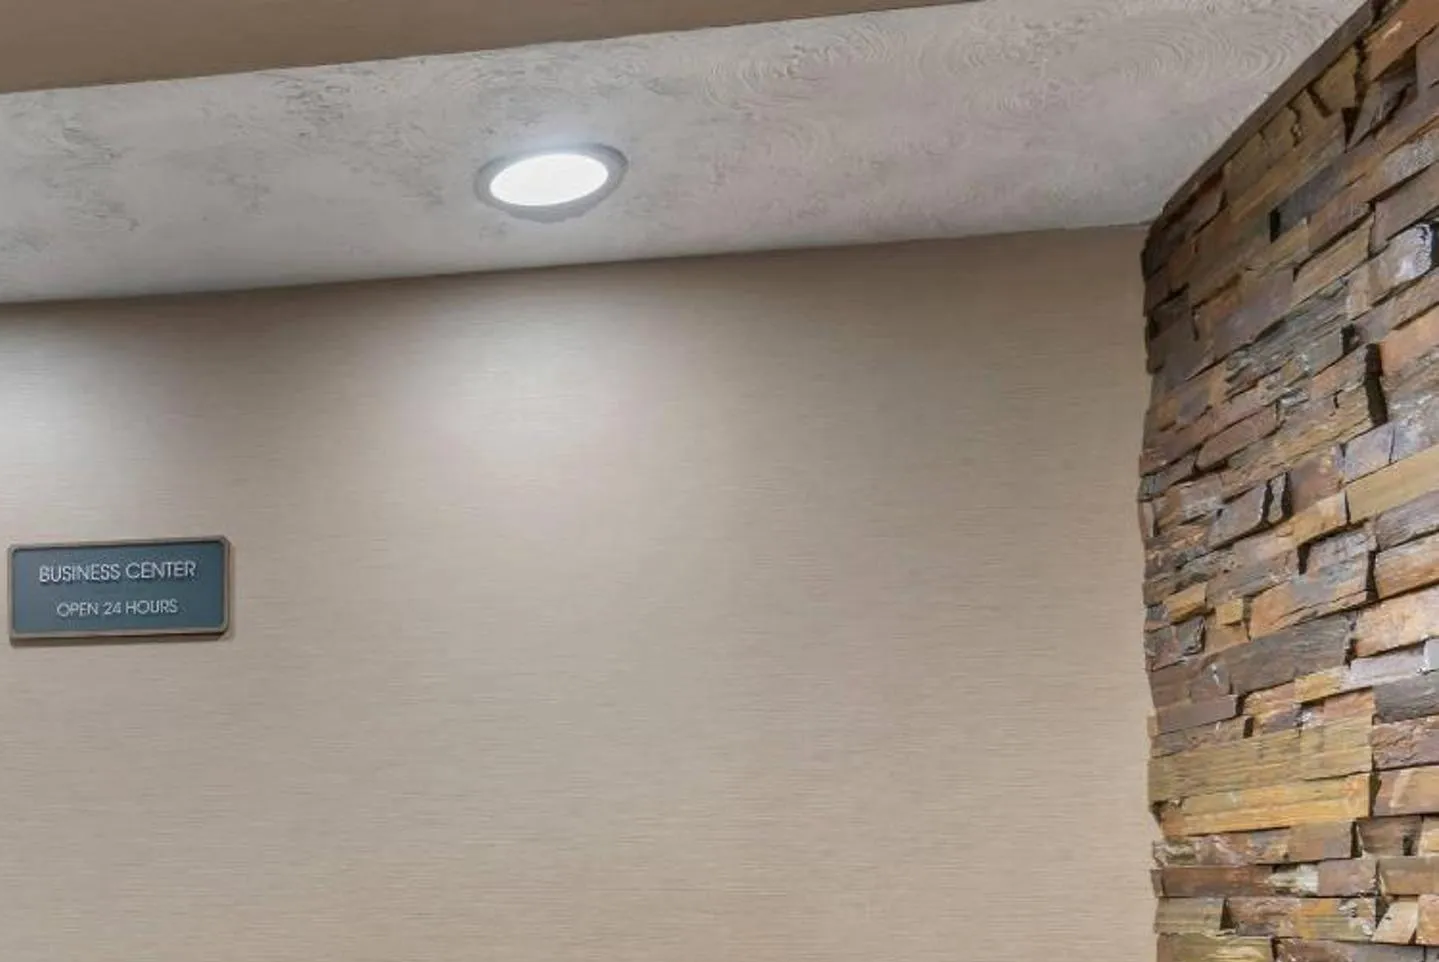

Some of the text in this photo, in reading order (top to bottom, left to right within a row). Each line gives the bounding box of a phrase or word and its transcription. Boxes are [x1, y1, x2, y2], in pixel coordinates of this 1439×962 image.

[39, 560, 197, 583] BUSINESS CENTER
[56, 598, 179, 618] OPEN 24 HOURS
